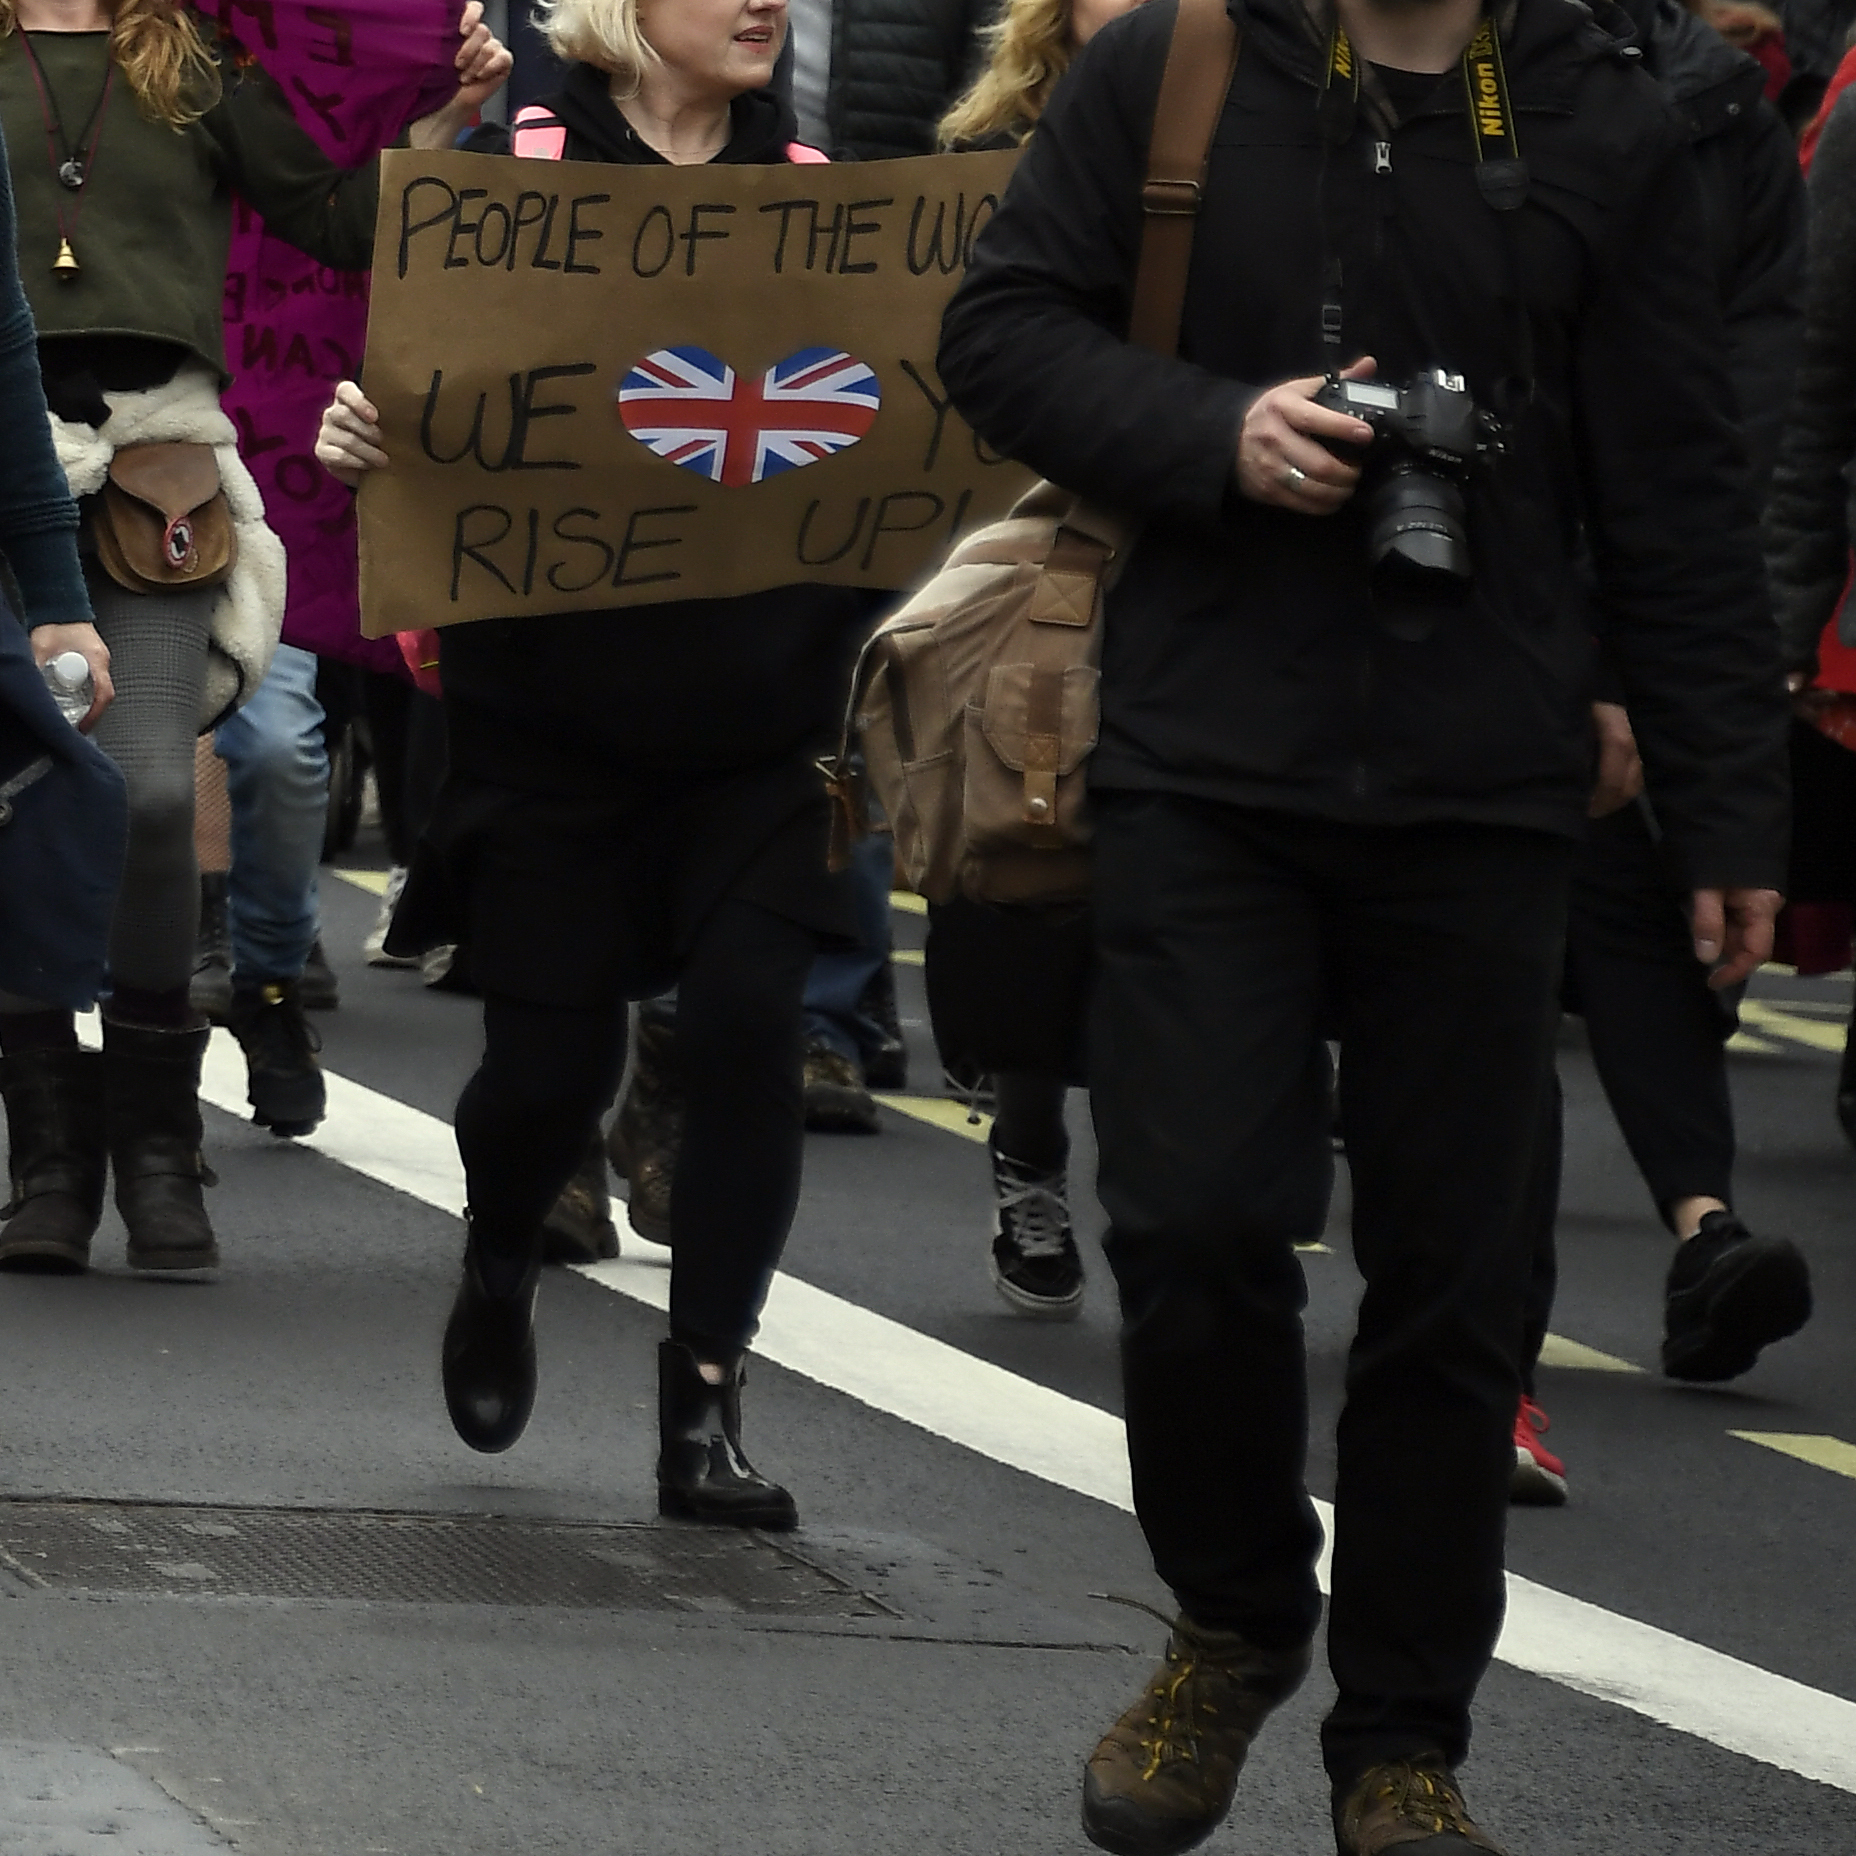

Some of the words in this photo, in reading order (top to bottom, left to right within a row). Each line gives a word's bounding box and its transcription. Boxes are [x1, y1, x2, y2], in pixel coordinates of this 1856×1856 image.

[1477, 62, 1506, 136] Nikon
[398, 176, 611, 279] PEOPLE
[632, 204, 737, 278] OF
[758, 198, 893, 275] THE
[907, 192, 999, 277] WO
[419, 363, 597, 473] WE
[449, 504, 698, 602] RISE
